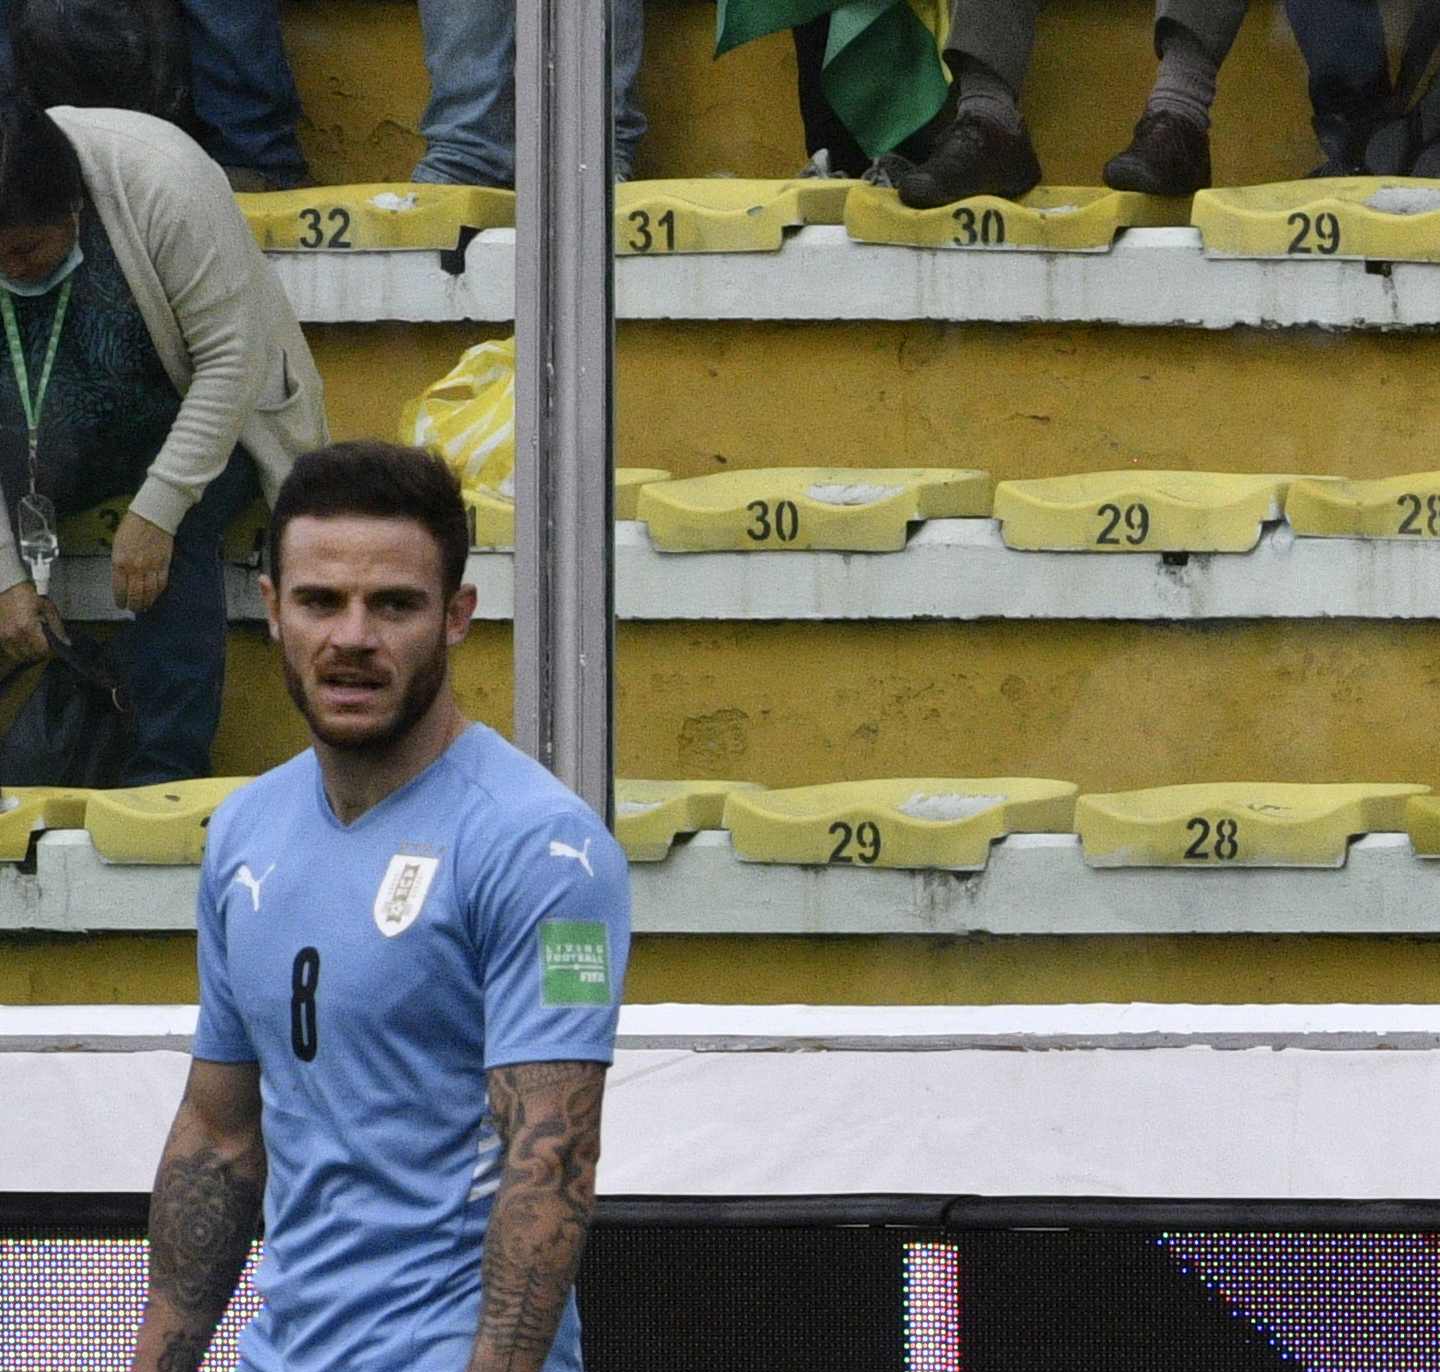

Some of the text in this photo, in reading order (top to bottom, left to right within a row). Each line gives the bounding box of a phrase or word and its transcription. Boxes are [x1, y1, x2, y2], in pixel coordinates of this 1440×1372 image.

[299, 208, 352, 249] 32
[627, 209, 677, 253] 31
[952, 208, 1006, 247] 30
[1286, 211, 1341, 255] 29
[745, 499, 800, 543] 30
[1095, 502, 1151, 546] 29
[828, 820, 883, 864] 29
[1184, 816, 1240, 861] 28
[290, 945, 320, 1064] 8
